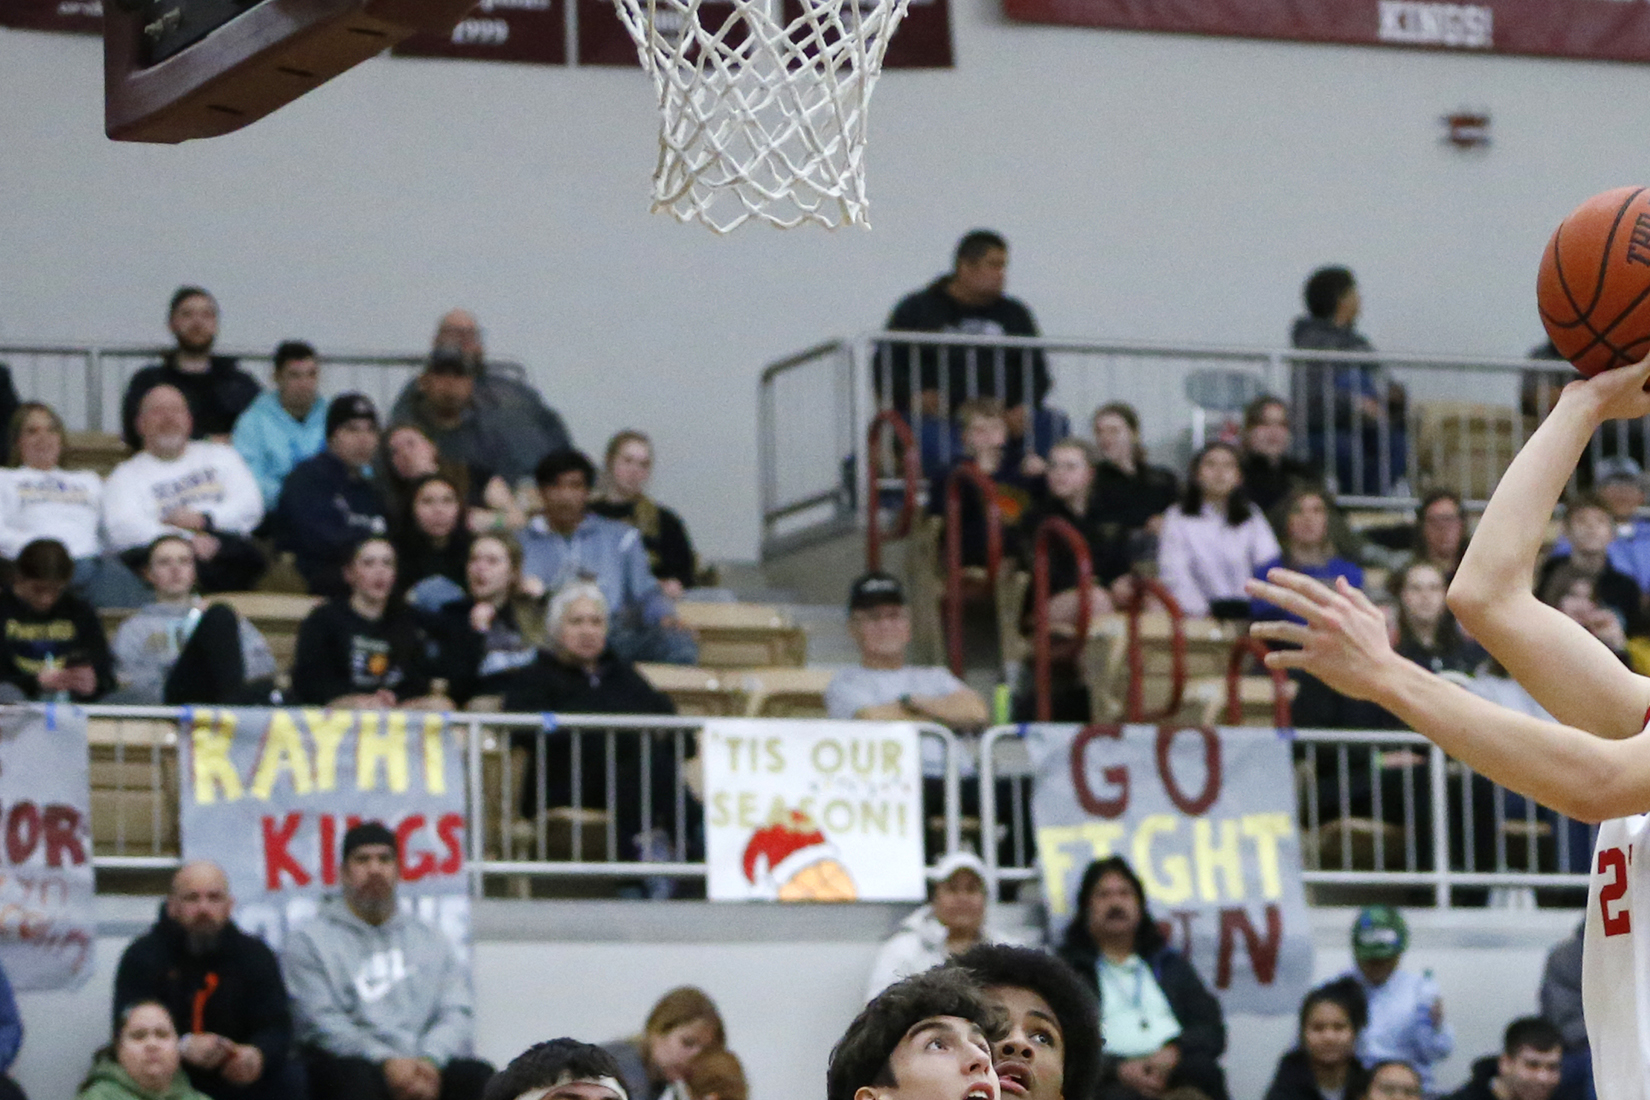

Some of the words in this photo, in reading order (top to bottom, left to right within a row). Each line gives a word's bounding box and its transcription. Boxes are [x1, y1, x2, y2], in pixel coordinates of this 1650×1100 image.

[191, 708, 449, 806] KAYHI
[811, 738, 904, 777] OUR
[1070, 722, 1223, 819] GO
[261, 811, 466, 890] KIGS
[1039, 813, 1294, 914] FIGHT
